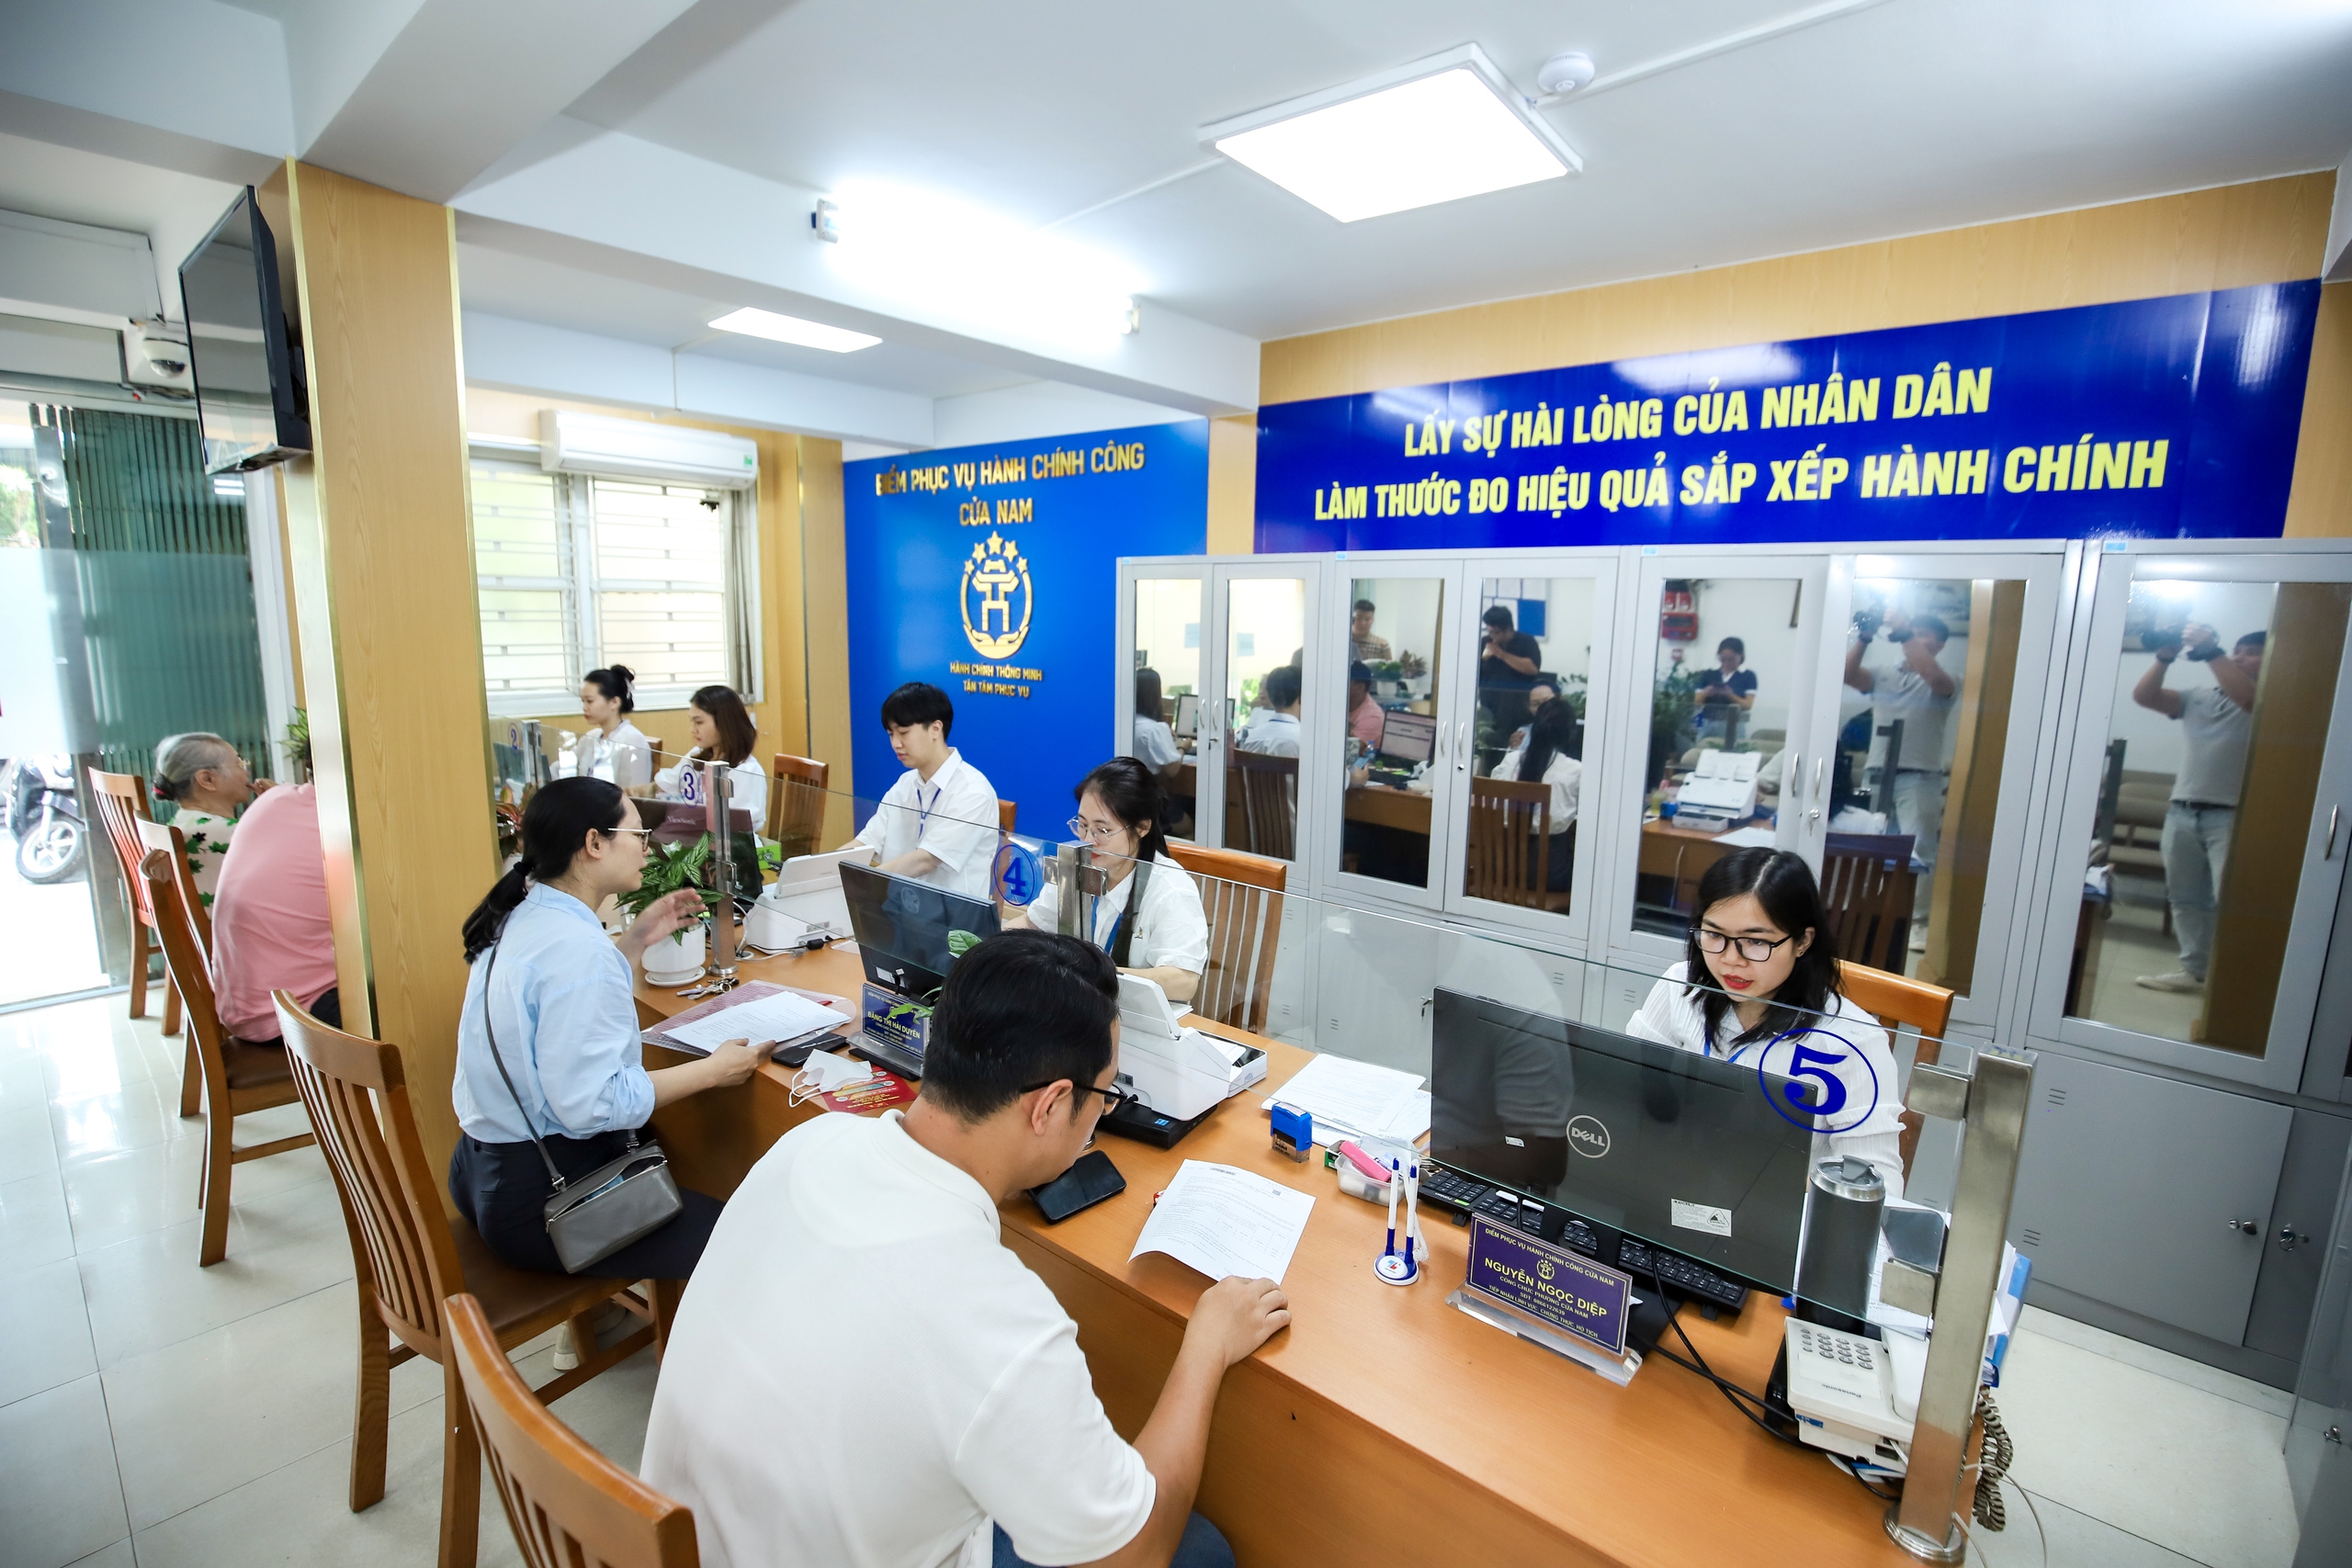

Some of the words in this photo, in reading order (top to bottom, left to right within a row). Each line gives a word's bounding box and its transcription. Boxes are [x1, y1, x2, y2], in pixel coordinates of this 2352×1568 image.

[1405, 409, 1455, 457] LẤY
[1463, 410, 1508, 458] SỰ
[1511, 401, 1564, 448] HÀI
[1573, 394, 1663, 444] LÒNG
[1673, 377, 1748, 435] CỦA
[1760, 372, 1881, 429] NHÂN
[1893, 361, 1993, 419] DÂN
[910, 466, 950, 495] PHỤC
[954, 462, 976, 491] VỤ
[980, 455, 1026, 485] HÀNH
[1032, 446, 1085, 479] CHÍNH
[1091, 439, 1146, 473] CÔNG
[1315, 481, 1367, 520] LÀM
[1374, 472, 1461, 517] THƯỚC
[1469, 477, 1510, 513] ĐO
[1517, 466, 1590, 518] HIỆU
[1600, 451, 1669, 513] QUẢ
[1679, 450, 1757, 505] SẮP
[1766, 444, 1849, 502] XẾP
[1860, 444, 1989, 498] HÀNH
[2003, 433, 2169, 493] CHÍNH
[959, 496, 991, 526] CỬA
[997, 497, 1033, 525] NAM
[950, 660, 970, 674] HÀNH
[996, 664, 1022, 679] THÔNG
[1023, 668, 1043, 682] MINH
[511, 728, 518, 750] 2
[684, 773, 695, 800] 3
[1002, 857, 1026, 897] 4
[1784, 1043, 1848, 1116] 5
[1571, 1126, 1606, 1147] DELL
[1500, 1235, 1517, 1246] PHỤC
[1600, 1275, 1614, 1287] NAM
[1485, 1258, 1534, 1287] NGUYỄN
[1537, 1280, 1575, 1303] NGỌC
[1577, 1298, 1608, 1317] DIỆP
[1575, 1308, 1589, 1319] NAM
